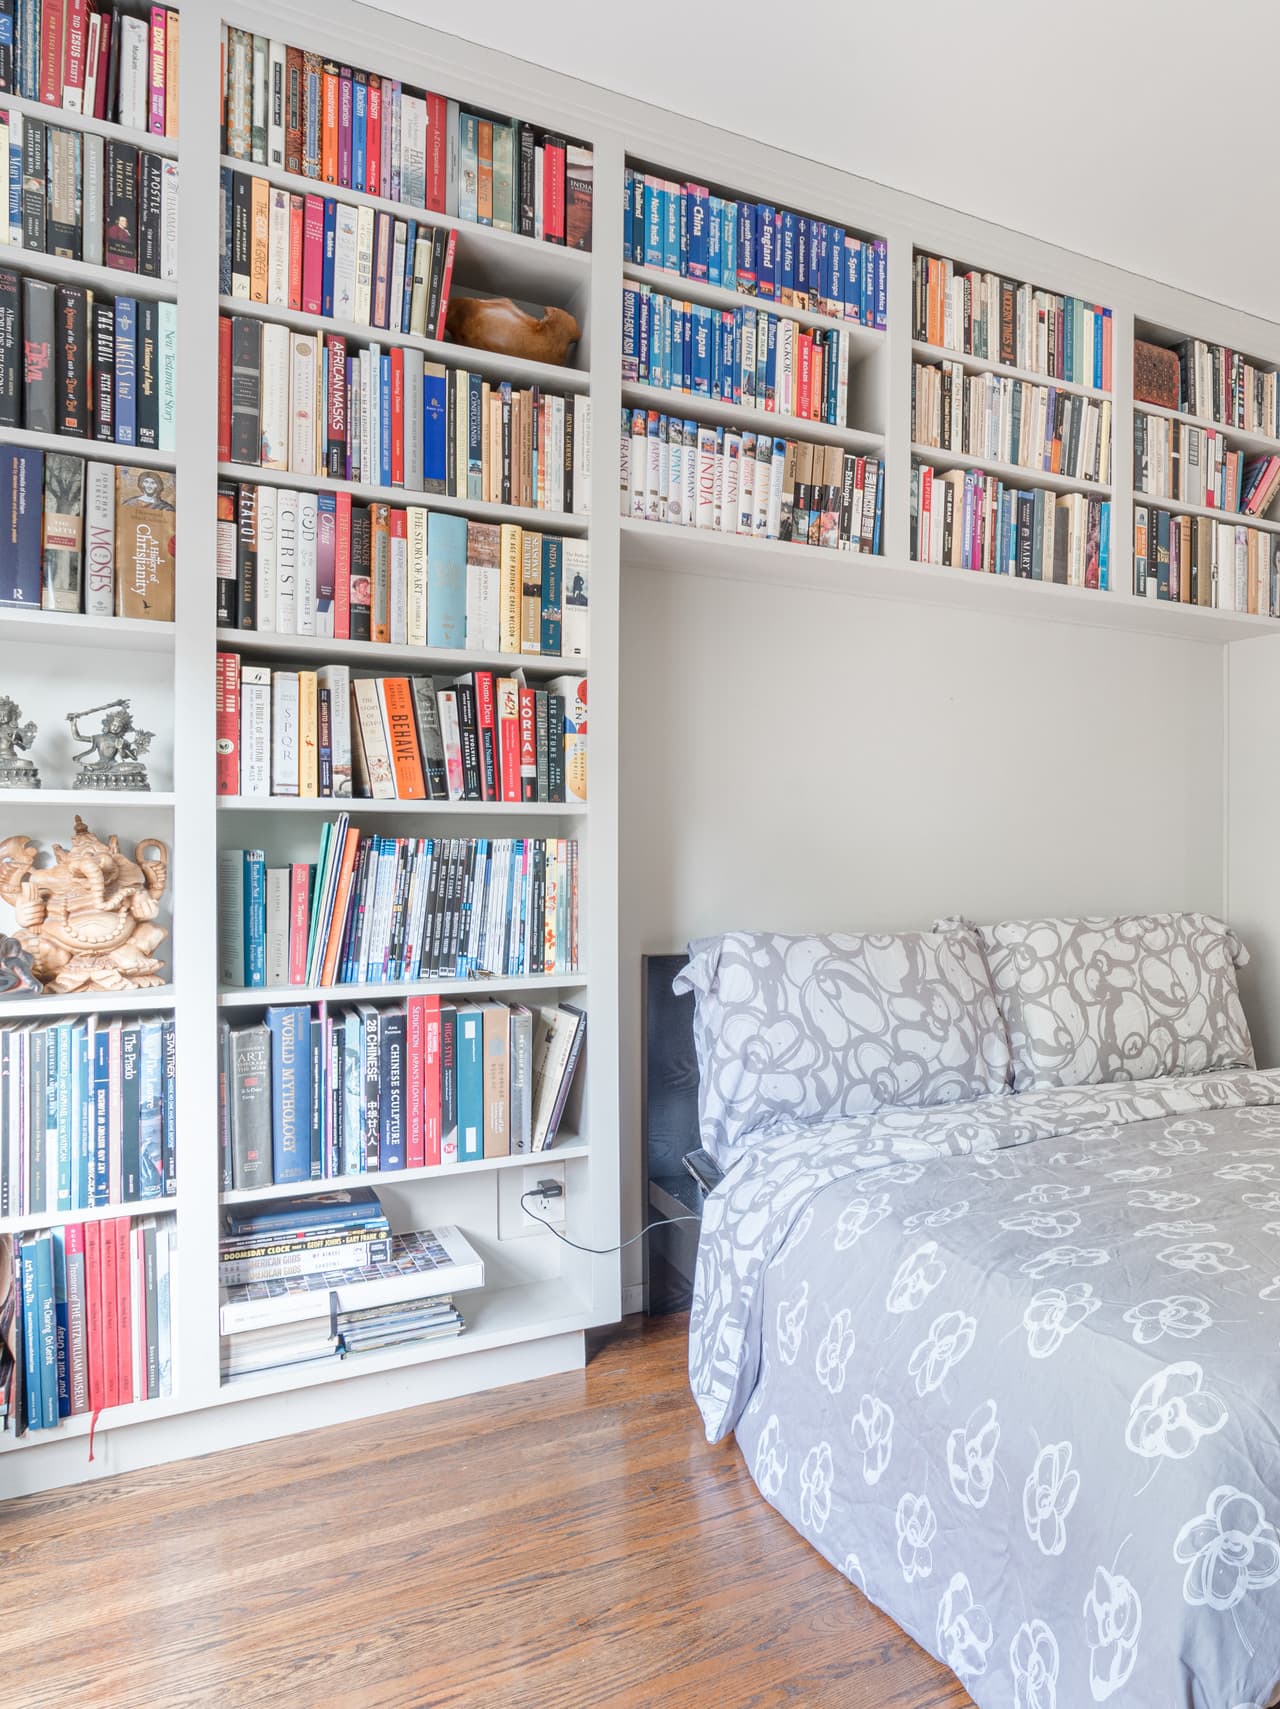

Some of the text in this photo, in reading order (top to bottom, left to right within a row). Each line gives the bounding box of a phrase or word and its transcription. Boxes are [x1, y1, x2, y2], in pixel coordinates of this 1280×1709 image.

[153, 27, 163, 88] EDDIE HUANG
[327, 77, 336, 128] Zoroastrianism
[342, 81, 351, 126] Confucianism
[356, 86, 366, 117] Daoism
[370, 90, 379, 119] Jainism
[116, 159, 124, 197] AMERICAN
[125, 162, 133, 199] THE FIRST
[151, 168, 160, 214] APOSTLE
[570, 180, 592, 188] INDIA
[634, 183, 643, 218] Thailand
[650, 198, 659, 246] North India
[668, 226, 676, 243] India
[693, 206, 703, 236] China
[761, 225, 773, 268] England
[784, 231, 792, 271] East Africa
[831, 245, 840, 297] Eastern Europe
[848, 257, 858, 282] Spain
[866, 262, 874, 295] Sri Lanka
[878, 288, 886, 311] Africa
[1003, 290, 1013, 344] MODERN TIMES
[97, 310, 113, 362] THE DEVIL
[623, 292, 635, 354] SOUTH-EAST ASIA
[673, 320, 683, 343] Tibet
[696, 326, 707, 358] Japan
[767, 323, 776, 349] Bhutan
[24, 340, 49, 383] DEVIL
[745, 330, 753, 370] TURKEY
[783, 325, 792, 373] ANGKOR
[163, 330, 175, 423] New Testament Story
[333, 342, 344, 430] AFRICAN MASKS
[470, 391, 478, 447] CONFUCIANISM
[620, 437, 630, 483] FRANCE
[651, 440, 660, 472] JAPAN
[671, 447, 682, 485] SPAIN
[687, 450, 696, 501] GERMANY
[699, 455, 715, 506] INDIA
[715, 457, 723, 503] MOSCOW
[727, 459, 738, 504] CHINA
[842, 471, 853, 506] Ethiopia
[241, 491, 255, 545] ZEALOT
[302, 506, 315, 542] GOD
[321, 514, 334, 544] China
[90, 525, 112, 592] MOSES
[130, 524, 152, 596] Christianity
[148, 547, 160, 572] History
[280, 511, 295, 600] CHRIST
[338, 512, 348, 612] THE ARTS OF CHINA
[353, 540, 361, 564] GREAT
[414, 511, 424, 595] THE STORY OF ART
[1022, 540, 1030, 570] MARY
[150, 575, 160, 583] of
[244, 580, 252, 602] ASLAN
[226, 659, 235, 713] STAMPED FROM
[482, 677, 492, 723] Homo Deus
[504, 690, 515, 716] 1421
[522, 697, 533, 752] KOREA
[575, 697, 583, 727] GENE
[391, 714, 414, 762] BEHAVE
[484, 732, 492, 748] Yuval
[166, 1033, 175, 1055] STAR
[367, 1020, 378, 1082] 28 CHINESE
[444, 1023, 452, 1044] HIGH
[124, 1034, 137, 1079] The Prado
[166, 1055, 175, 1078] TREK
[239, 1051, 265, 1063] ART
[412, 1006, 421, 1144] SEDUCTION JAPAN'S FLOATING WORLD
[282, 1014, 296, 1153] WORLD MYTHOLOGY
[391, 1044, 399, 1145] CHINESE SCULPTURE
[224, 1232, 377, 1260] DOOMSDAY CLOCK GEOFF JOHNS GARY FRANK
[70, 1264, 79, 1293] Treasures
[71, 1303, 81, 1319] THE
[57, 1326, 66, 1348] Orsay
[72, 1321, 83, 1370] FITZWILLIAM
[59, 1363, 67, 1378] visit
[60, 1382, 68, 1398] your
[73, 1373, 84, 1407] MUSEUM
